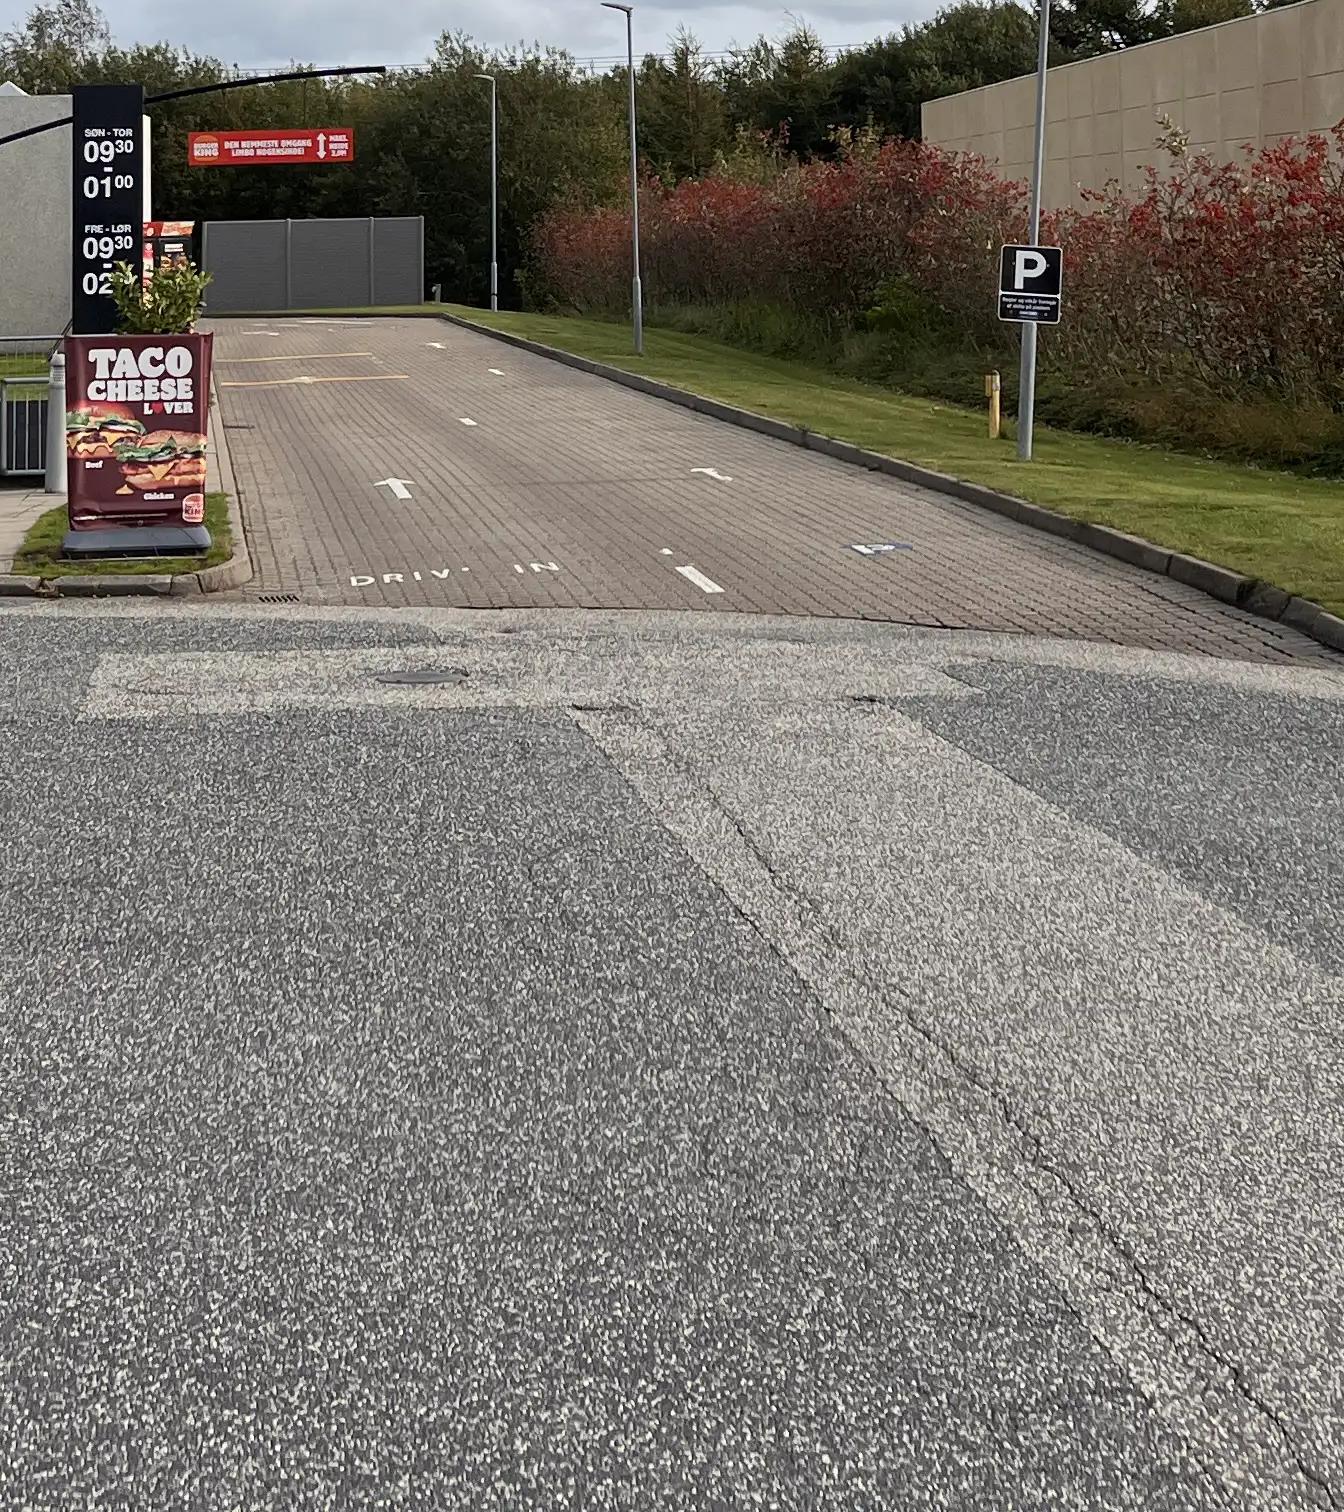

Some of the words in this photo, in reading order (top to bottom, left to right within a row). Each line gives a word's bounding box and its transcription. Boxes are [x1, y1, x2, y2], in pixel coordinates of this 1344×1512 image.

[84, 128, 106, 137] SØN
[113, 128, 133, 137] TOR
[85, 225, 104, 233] FRE
[1014, 250, 1047, 289] P
[88, 346, 193, 379] TACO
[87, 378, 193, 402] CHEESE
[513, 561, 559, 574] IN
